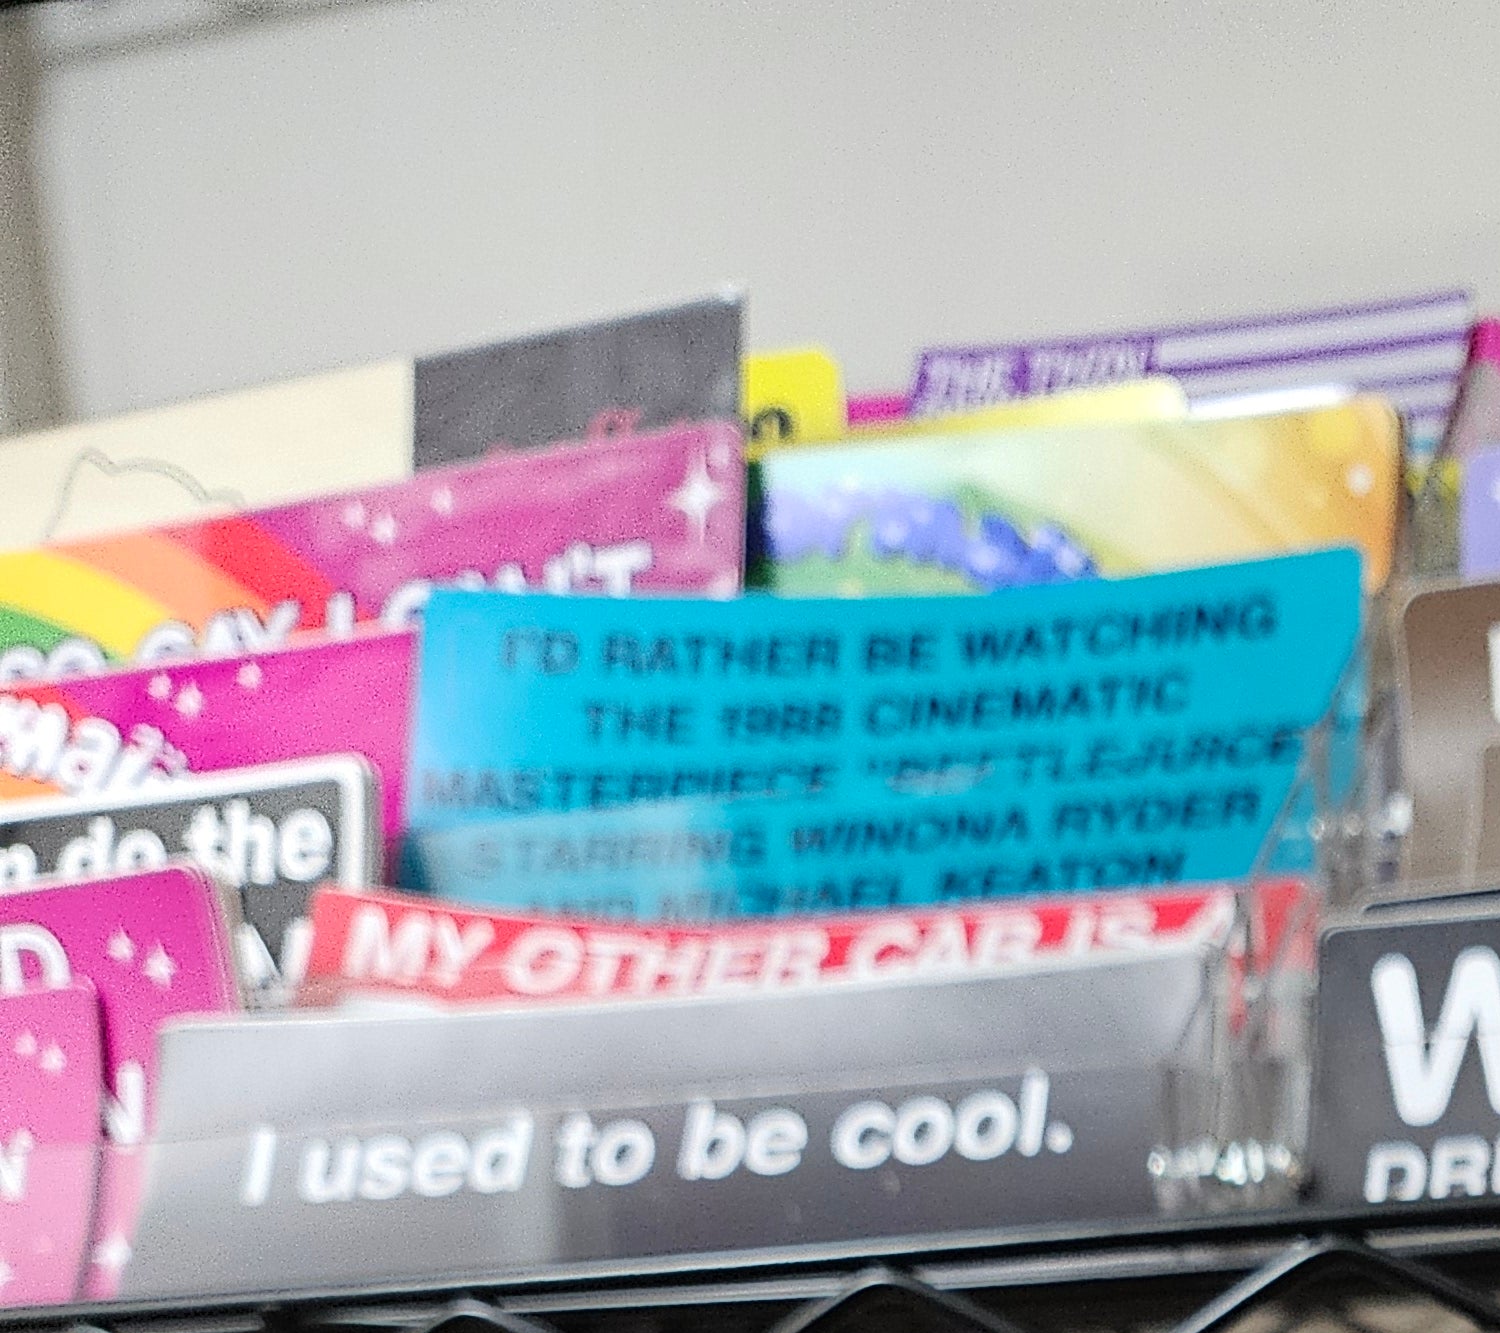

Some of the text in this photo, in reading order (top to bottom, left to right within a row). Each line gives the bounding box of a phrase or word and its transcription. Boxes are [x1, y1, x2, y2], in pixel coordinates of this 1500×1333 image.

[600, 622, 843, 681] RATHER
[859, 615, 937, 677] BE
[956, 592, 1279, 671] WATCHING
[582, 698, 697, 749] THE
[862, 668, 1192, 738] CINEMATIC
[184, 797, 334, 886] the
[1049, 785, 1262, 839] RYDER
[340, 902, 496, 988] MY
[500, 902, 832, 1000] OTHER
[239, 1066, 1075, 1207] I used to be cool.
